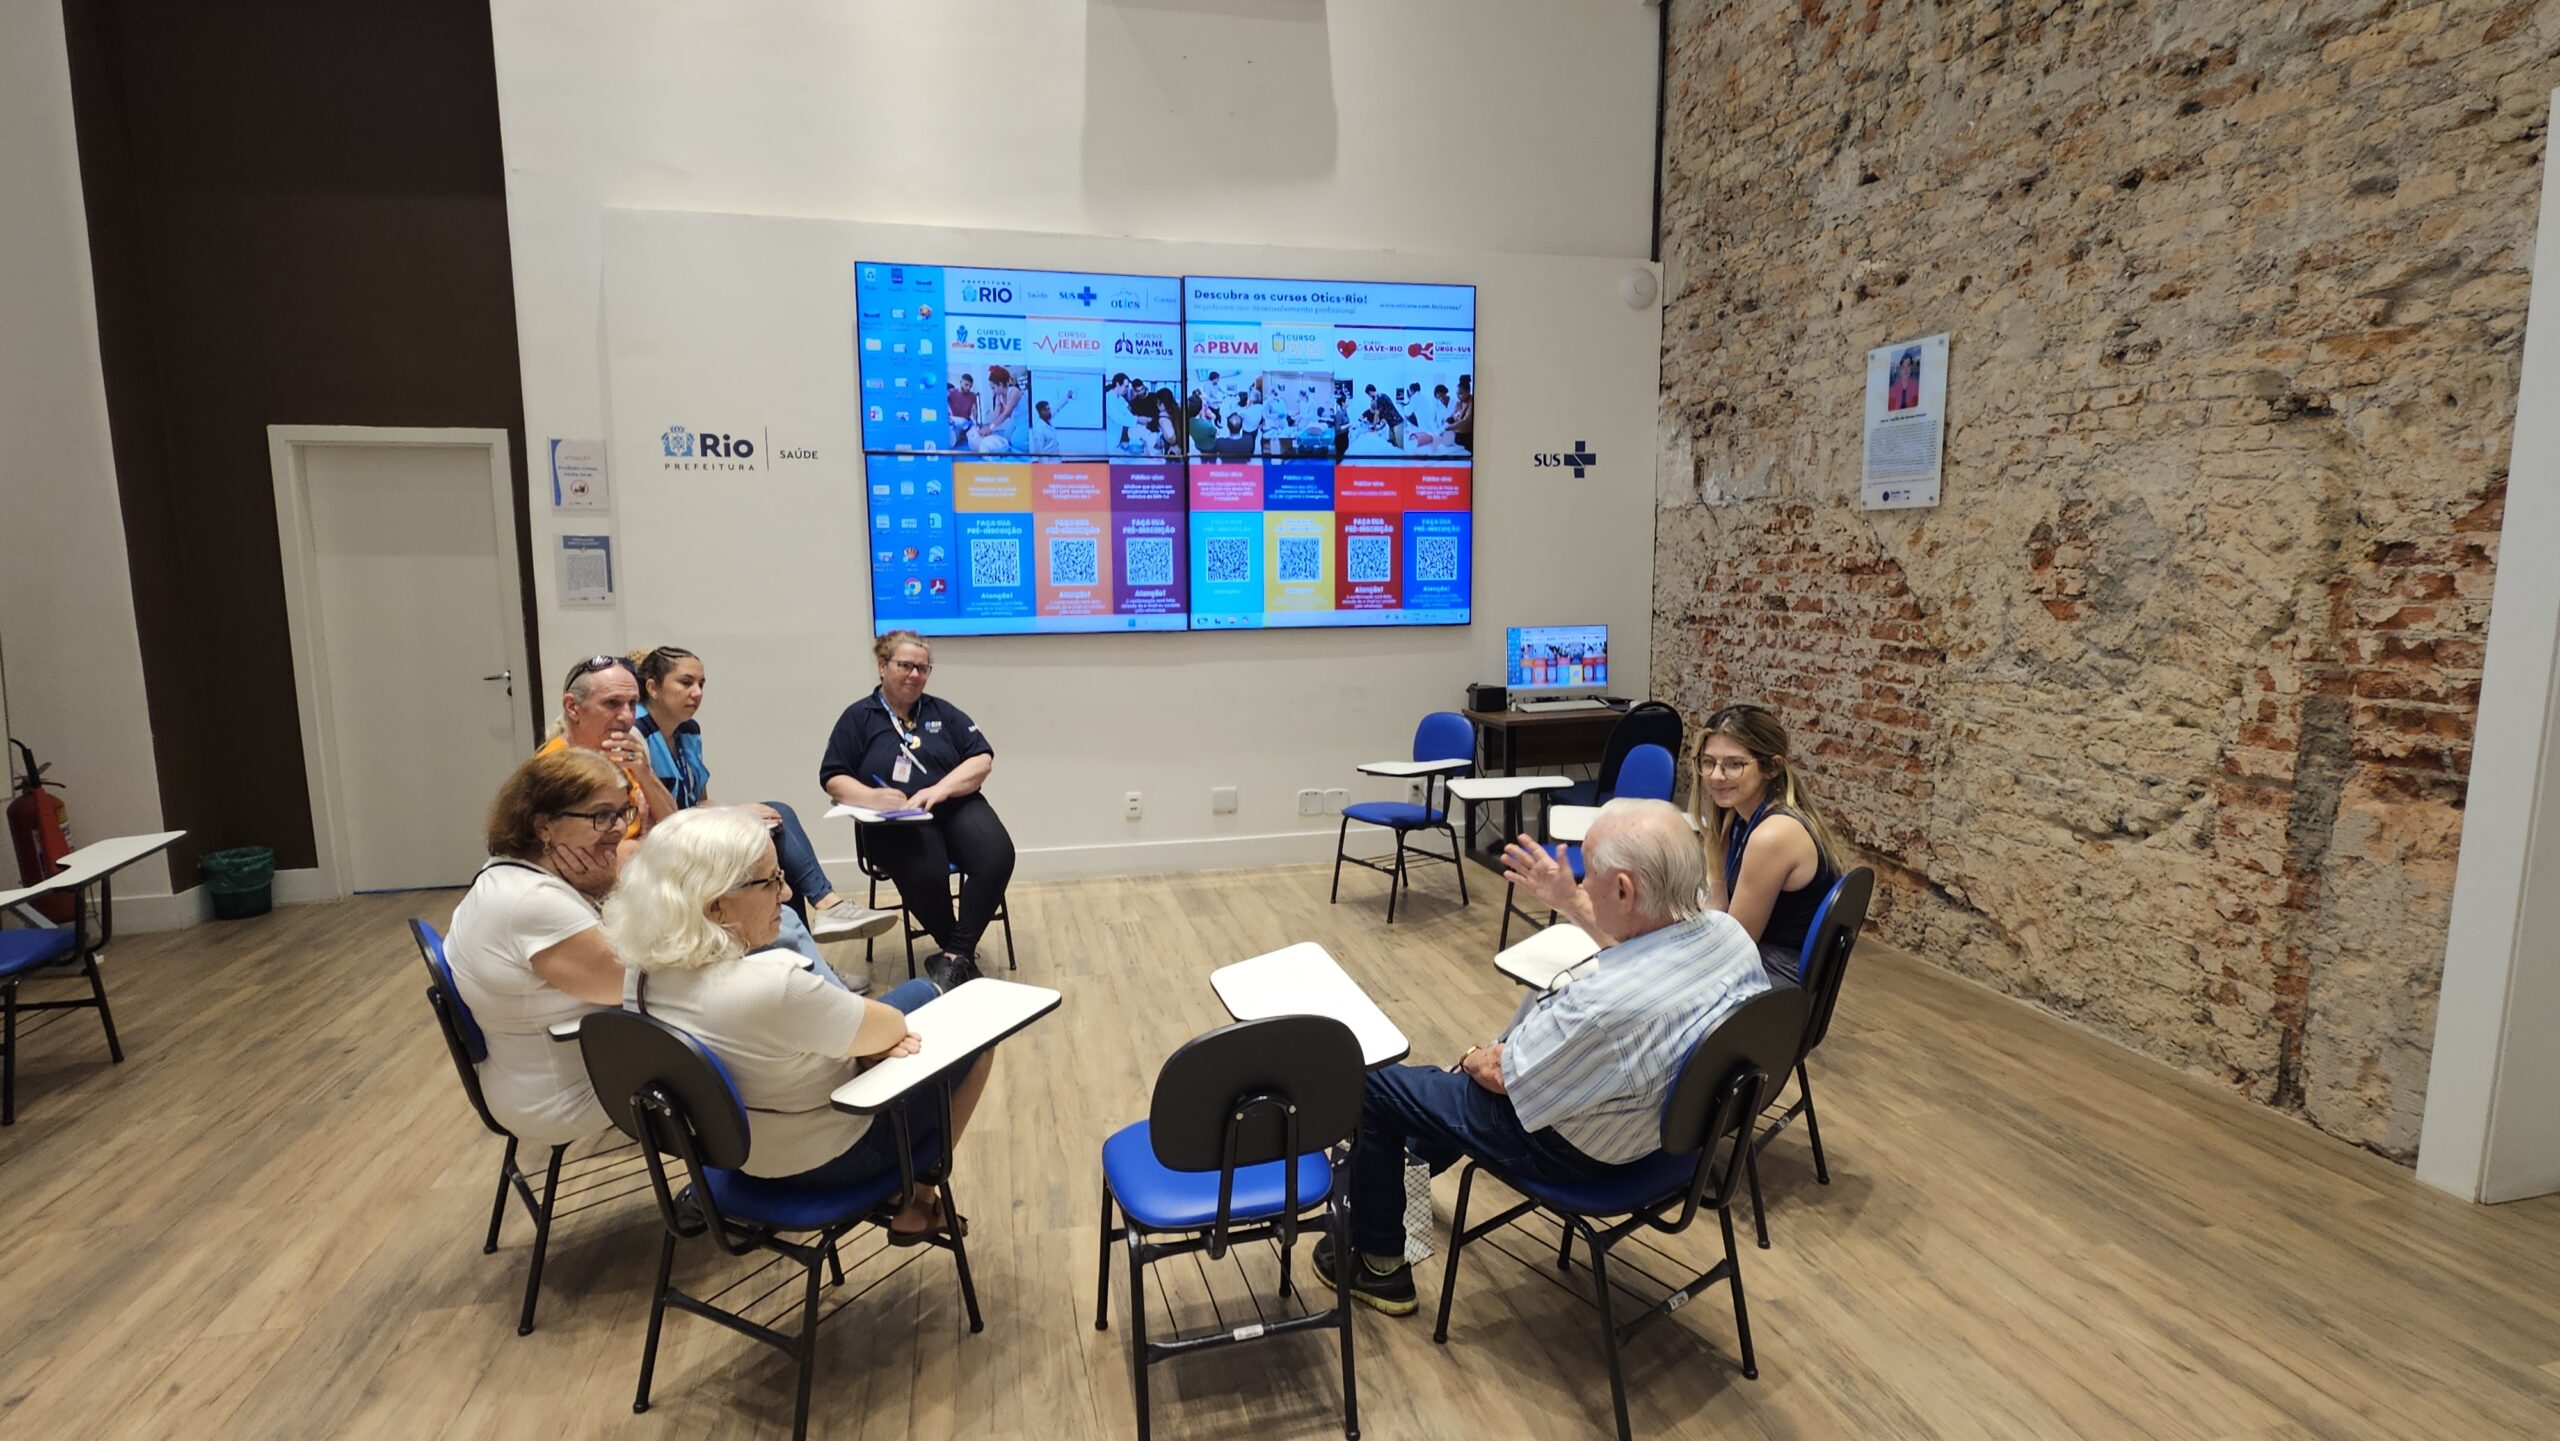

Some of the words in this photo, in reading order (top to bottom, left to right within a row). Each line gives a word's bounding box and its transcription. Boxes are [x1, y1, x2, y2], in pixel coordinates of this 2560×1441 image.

[979, 287, 1013, 303] RIO
[1059, 291, 1076, 300] SUS
[1194, 289, 1250, 300] Descubra
[1253, 293, 1266, 301] os
[1270, 293, 1308, 302] cursos
[1311, 292, 1368, 305] Otics-Rio!
[976, 328, 1006, 336] CURSO
[1057, 331, 1087, 339] CURSO
[1135, 332, 1163, 340] CURSO
[976, 336, 1022, 351] SBVE
[1058, 338, 1101, 350] IEMED
[1135, 340, 1164, 348] MANE
[1207, 341, 1259, 355] PBVM
[1135, 347, 1174, 356] VA-SUS
[1363, 345, 1403, 353] SAVE-RIO
[699, 433, 754, 458] Rio
[779, 447, 819, 460] SAÚDE
[1534, 453, 1561, 467] SUS
[664, 463, 755, 471] PREFEITURA
[981, 591, 1013, 601] Atenção!
